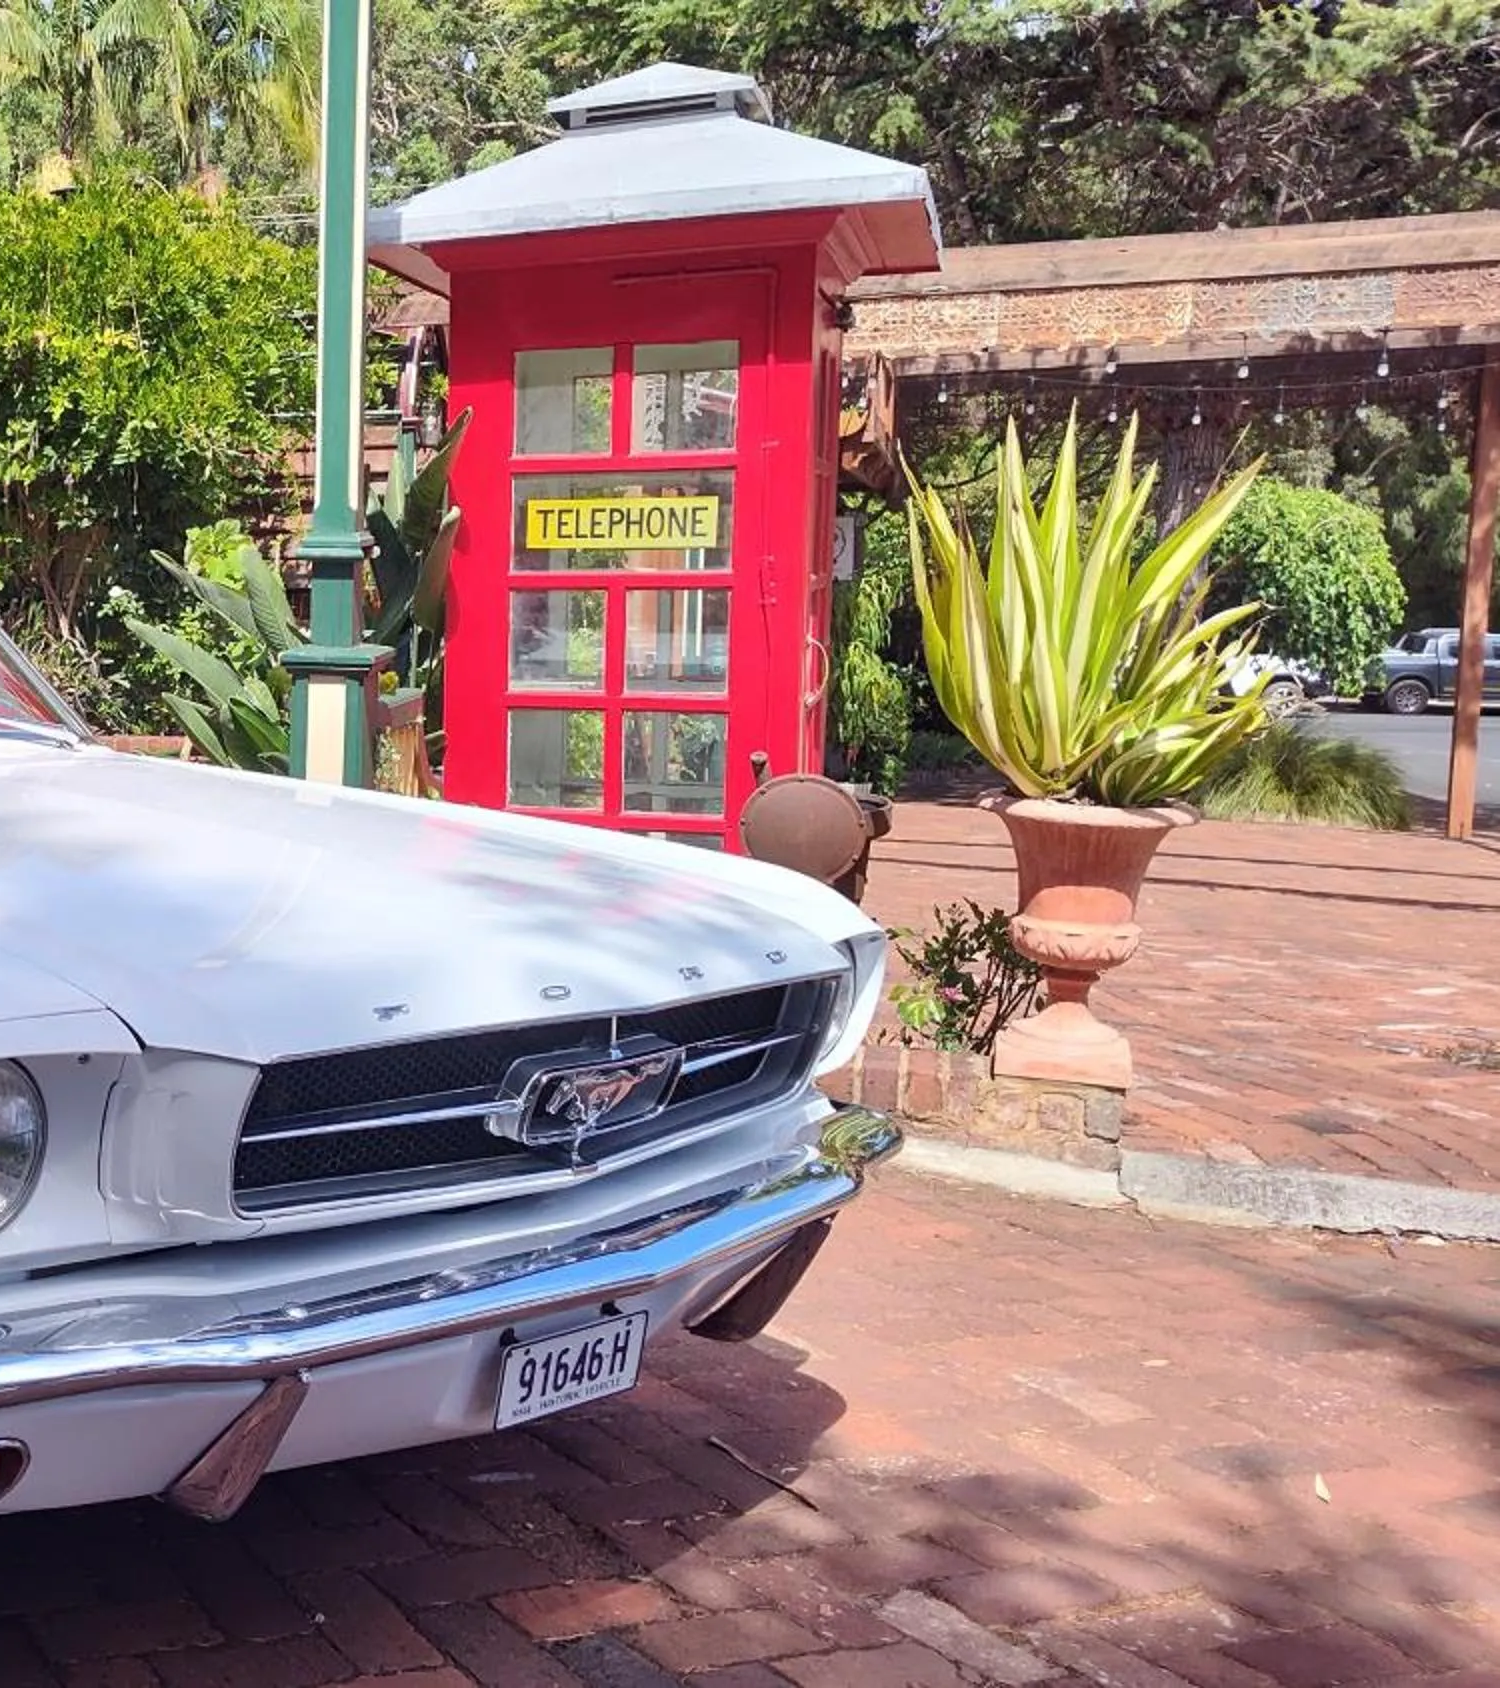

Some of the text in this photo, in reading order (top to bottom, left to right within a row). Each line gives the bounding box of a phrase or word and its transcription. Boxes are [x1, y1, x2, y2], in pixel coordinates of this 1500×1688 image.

[536, 507, 708, 539] TELEPHONE
[519, 1328, 631, 1403] 91646 H
